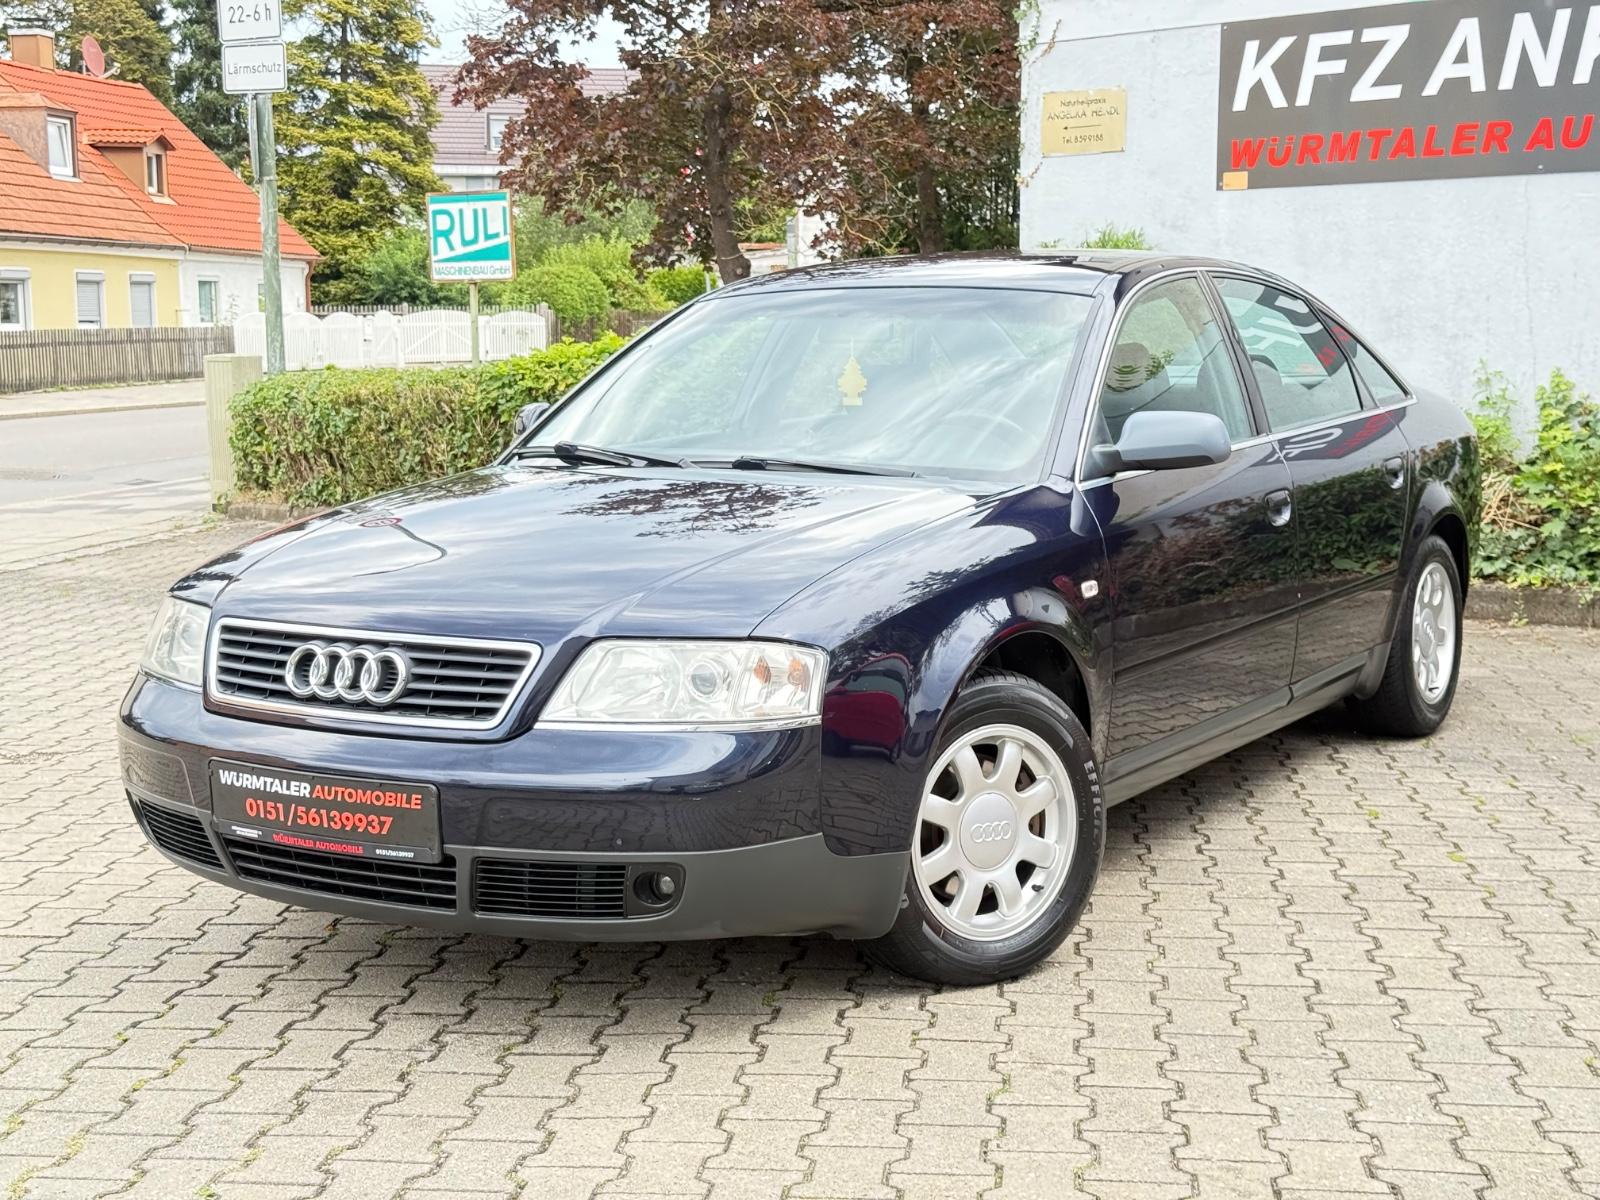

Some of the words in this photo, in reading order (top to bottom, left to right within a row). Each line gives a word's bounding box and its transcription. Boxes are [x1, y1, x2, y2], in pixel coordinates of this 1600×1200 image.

[228, 4, 260, 23] 22-6
[265, 3, 271, 21] h
[228, 62, 282, 75] Lärmschutz
[1232, 24, 1410, 112] KFZ
[1231, 120, 1513, 169] WÜRMTALER
[431, 206, 508, 256] RULI
[489, 265, 511, 275] GmbH
[219, 769, 310, 798] WÜRMTALER
[312, 784, 422, 809] AUTOMOBILE
[245, 798, 393, 835] 0151/56139937
[315, 841, 364, 854] AUTOMOBILE
